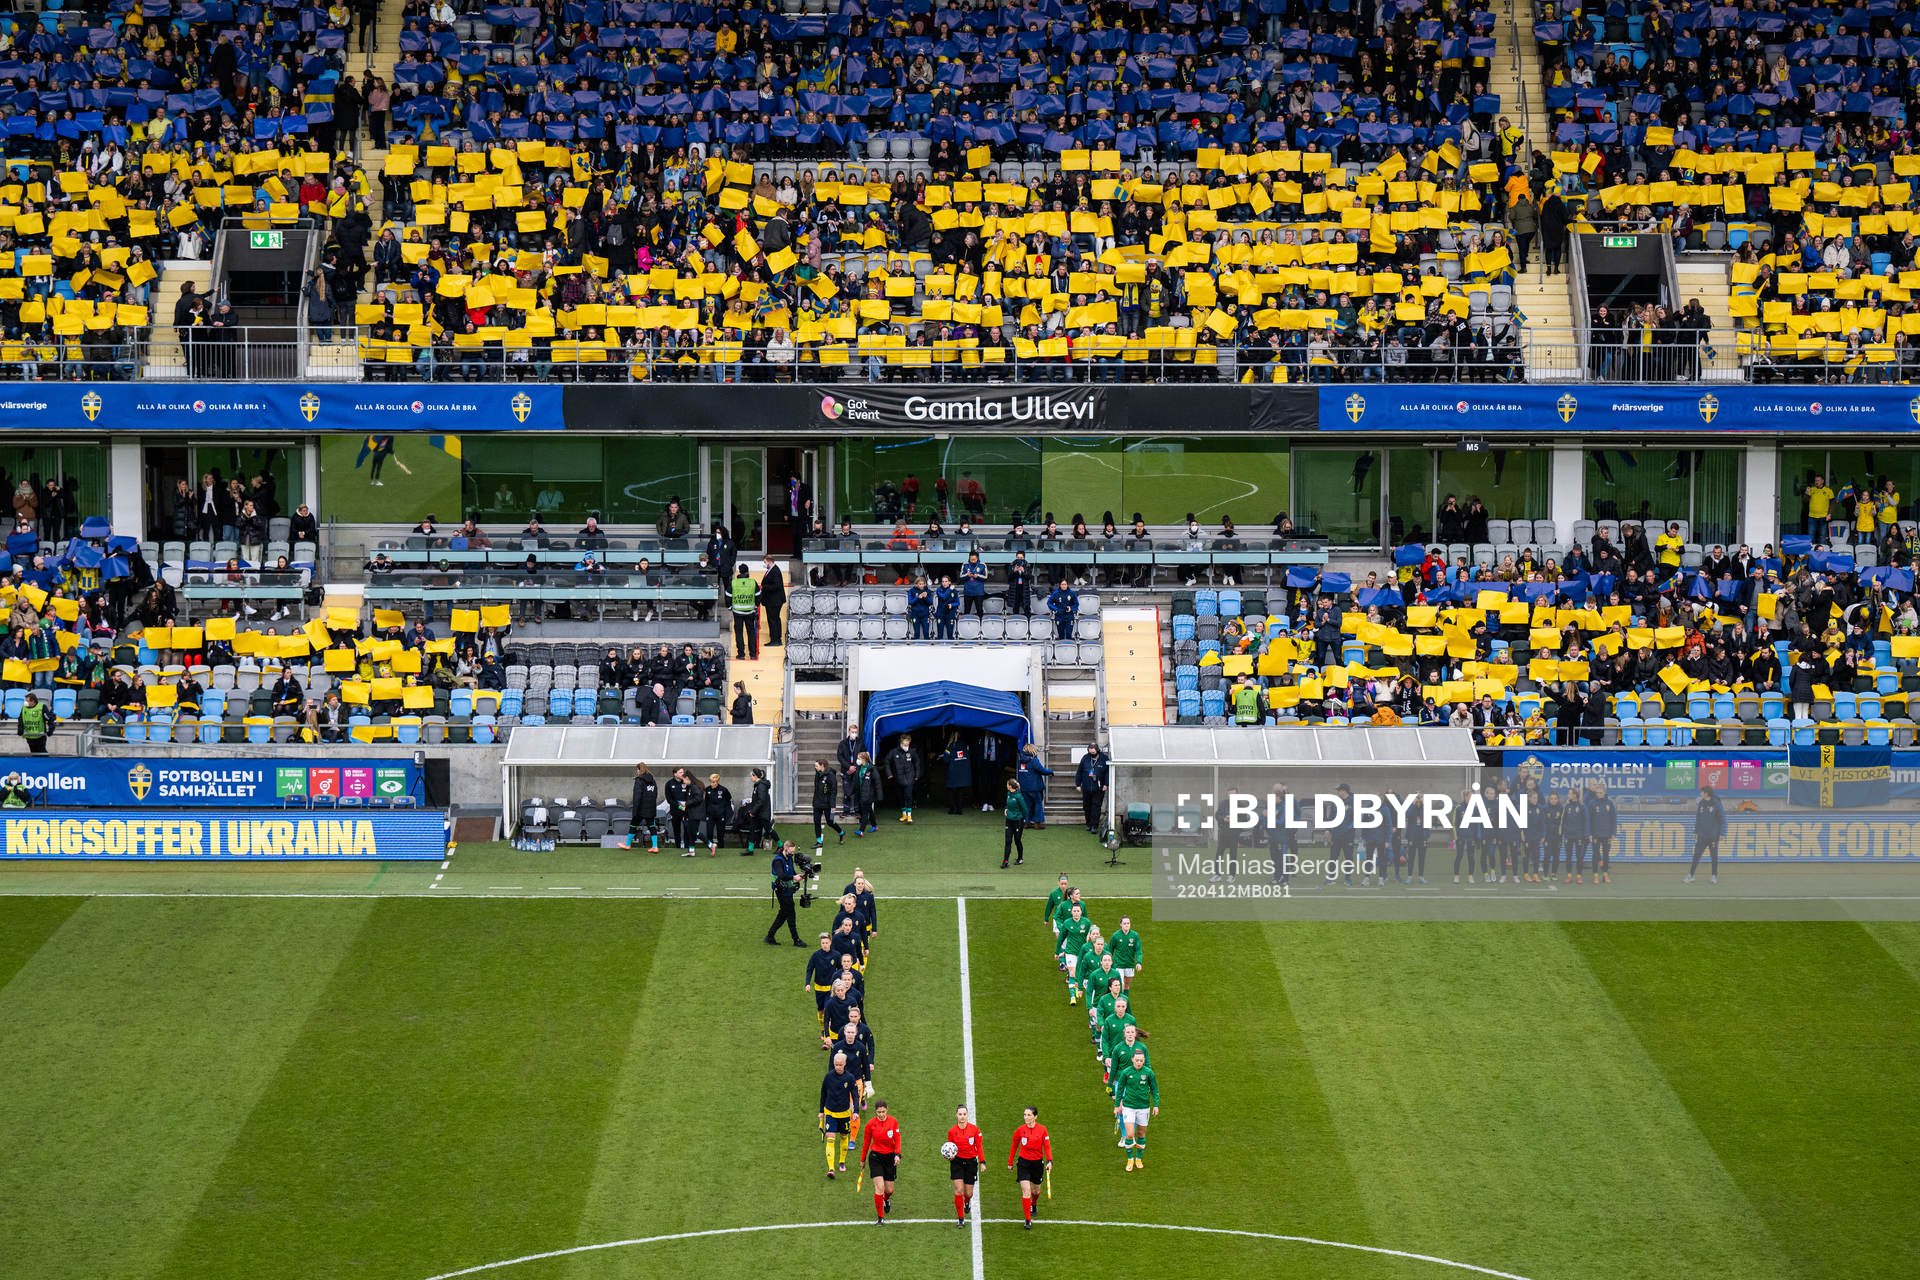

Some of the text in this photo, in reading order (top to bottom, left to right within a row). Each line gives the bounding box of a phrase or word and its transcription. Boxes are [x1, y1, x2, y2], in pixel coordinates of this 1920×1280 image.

[847, 399, 868, 410] Got
[904, 396, 1095, 421] Gamla Ullevi
[848, 410, 880, 420] Event
[1466, 443, 1479, 451] M5
[1550, 763, 1653, 774] FOTBOLLEN I
[1799, 770, 1814, 779] VI
[1832, 768, 1889, 780] HISTORIA
[159, 770, 262, 782] FOTBOLLEN I
[1822, 746, 1831, 806] SKAPAR
[159, 783, 256, 797] SAMHÄLLET
[5, 819, 377, 855] KRIGSOFFER I UKRAINA
